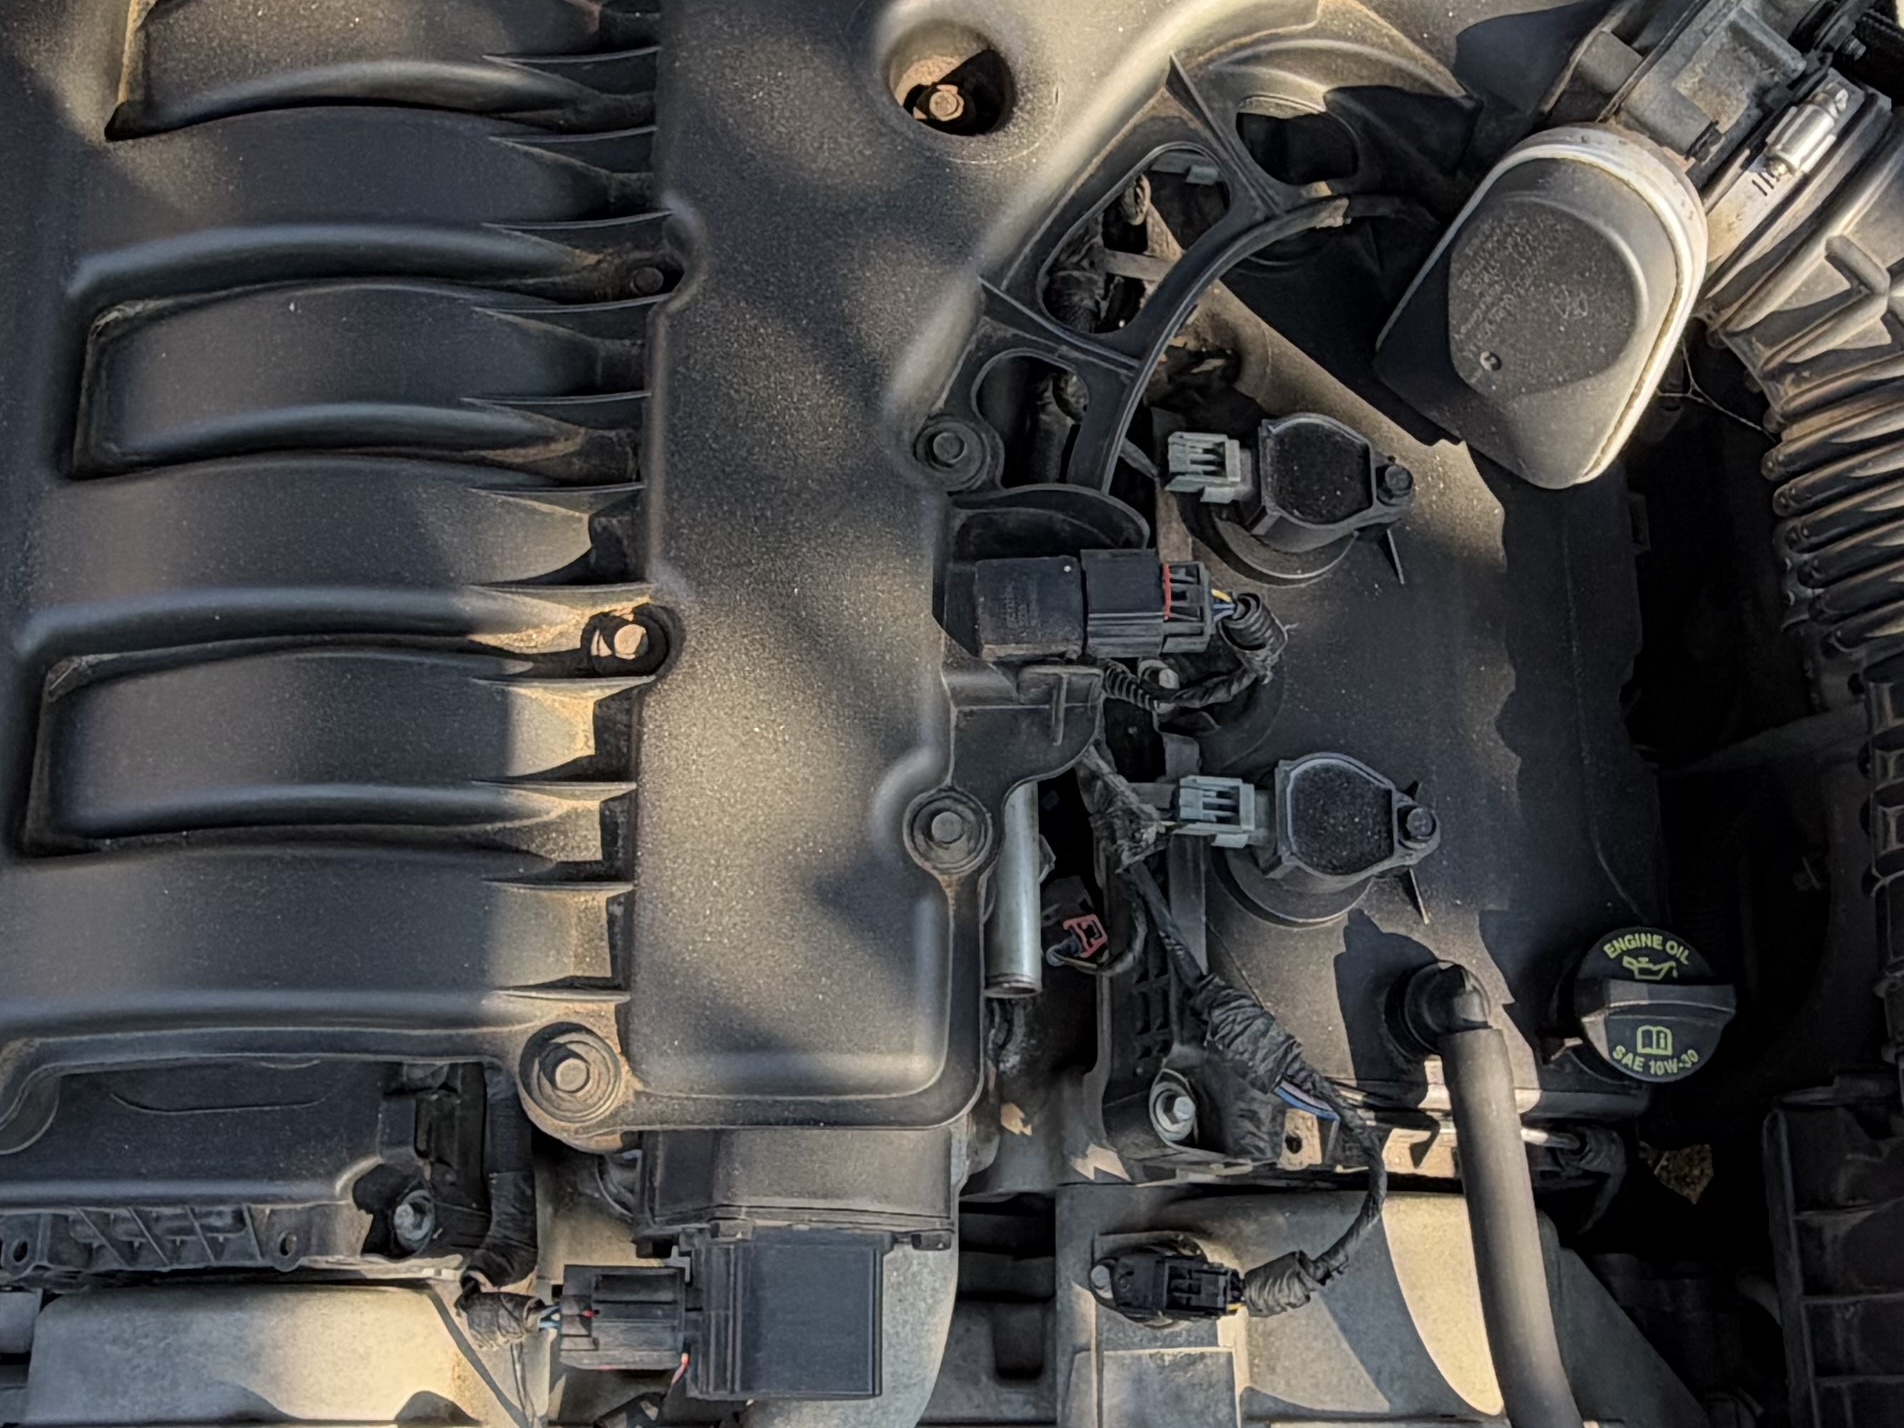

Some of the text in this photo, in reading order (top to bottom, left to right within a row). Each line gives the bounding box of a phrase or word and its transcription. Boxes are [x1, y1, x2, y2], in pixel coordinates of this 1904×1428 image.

[1603, 932, 1691, 965] ENGINE OIL
[1612, 1045, 1699, 1075] SAE 10W-30
